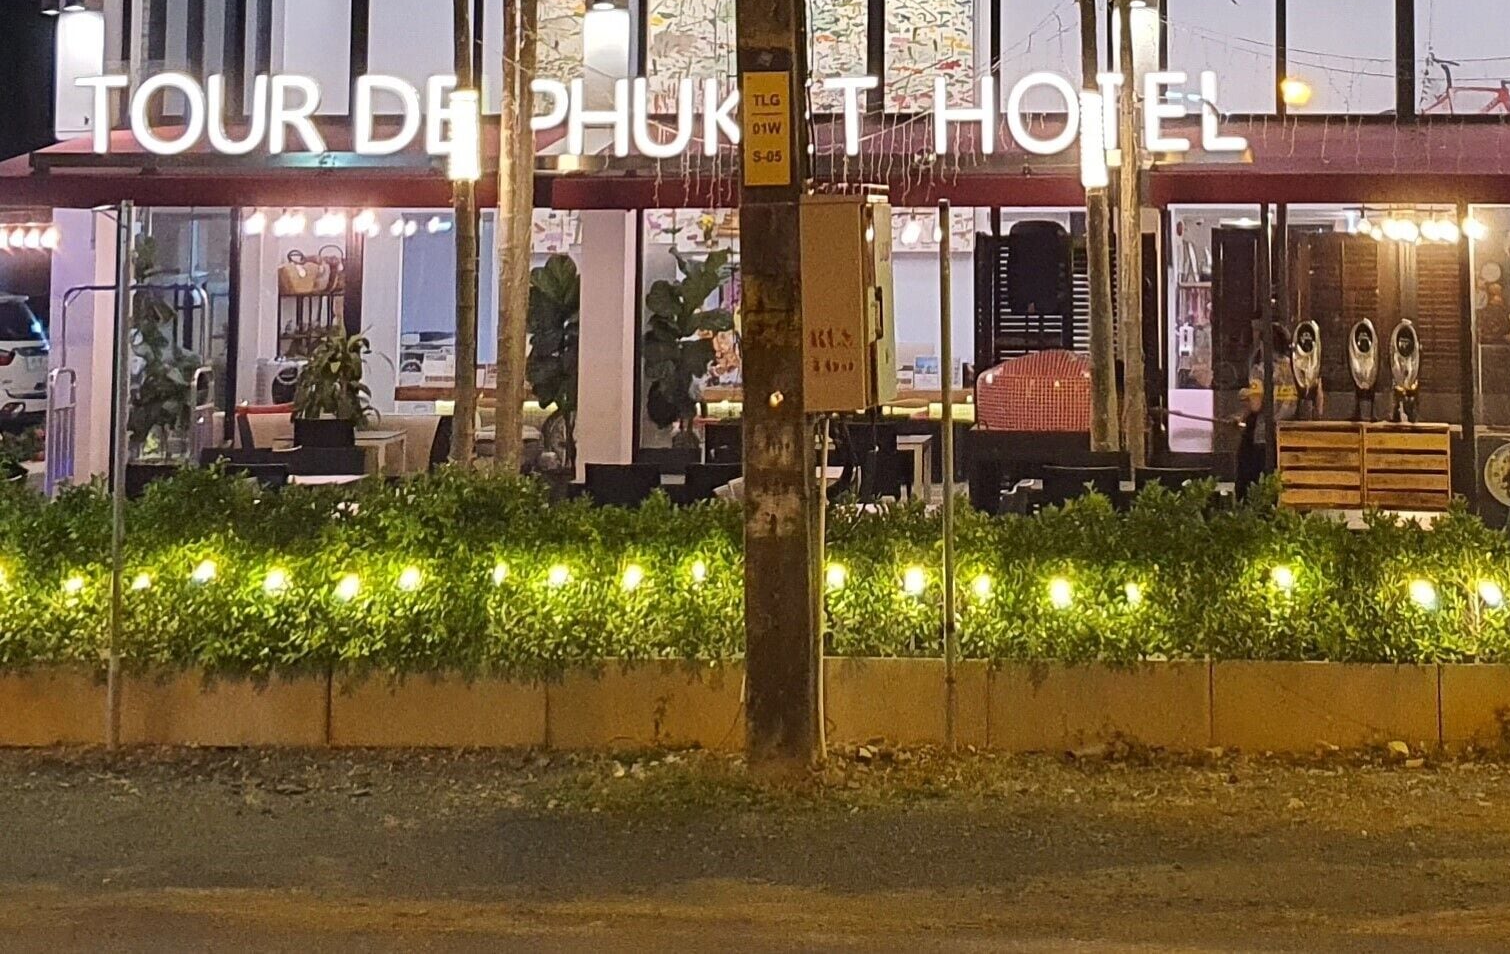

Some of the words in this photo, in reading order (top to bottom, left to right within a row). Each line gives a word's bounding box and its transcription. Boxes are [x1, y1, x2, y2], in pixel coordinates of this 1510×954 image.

[753, 93, 781, 107] TLG
[74, 73, 326, 155] TOUR
[354, 73, 464, 156] DE
[529, 76, 879, 157] PHUKT
[933, 70, 1249, 156] HOTEL
[752, 121, 782, 135] 01W
[752, 149, 783, 163] S-05
